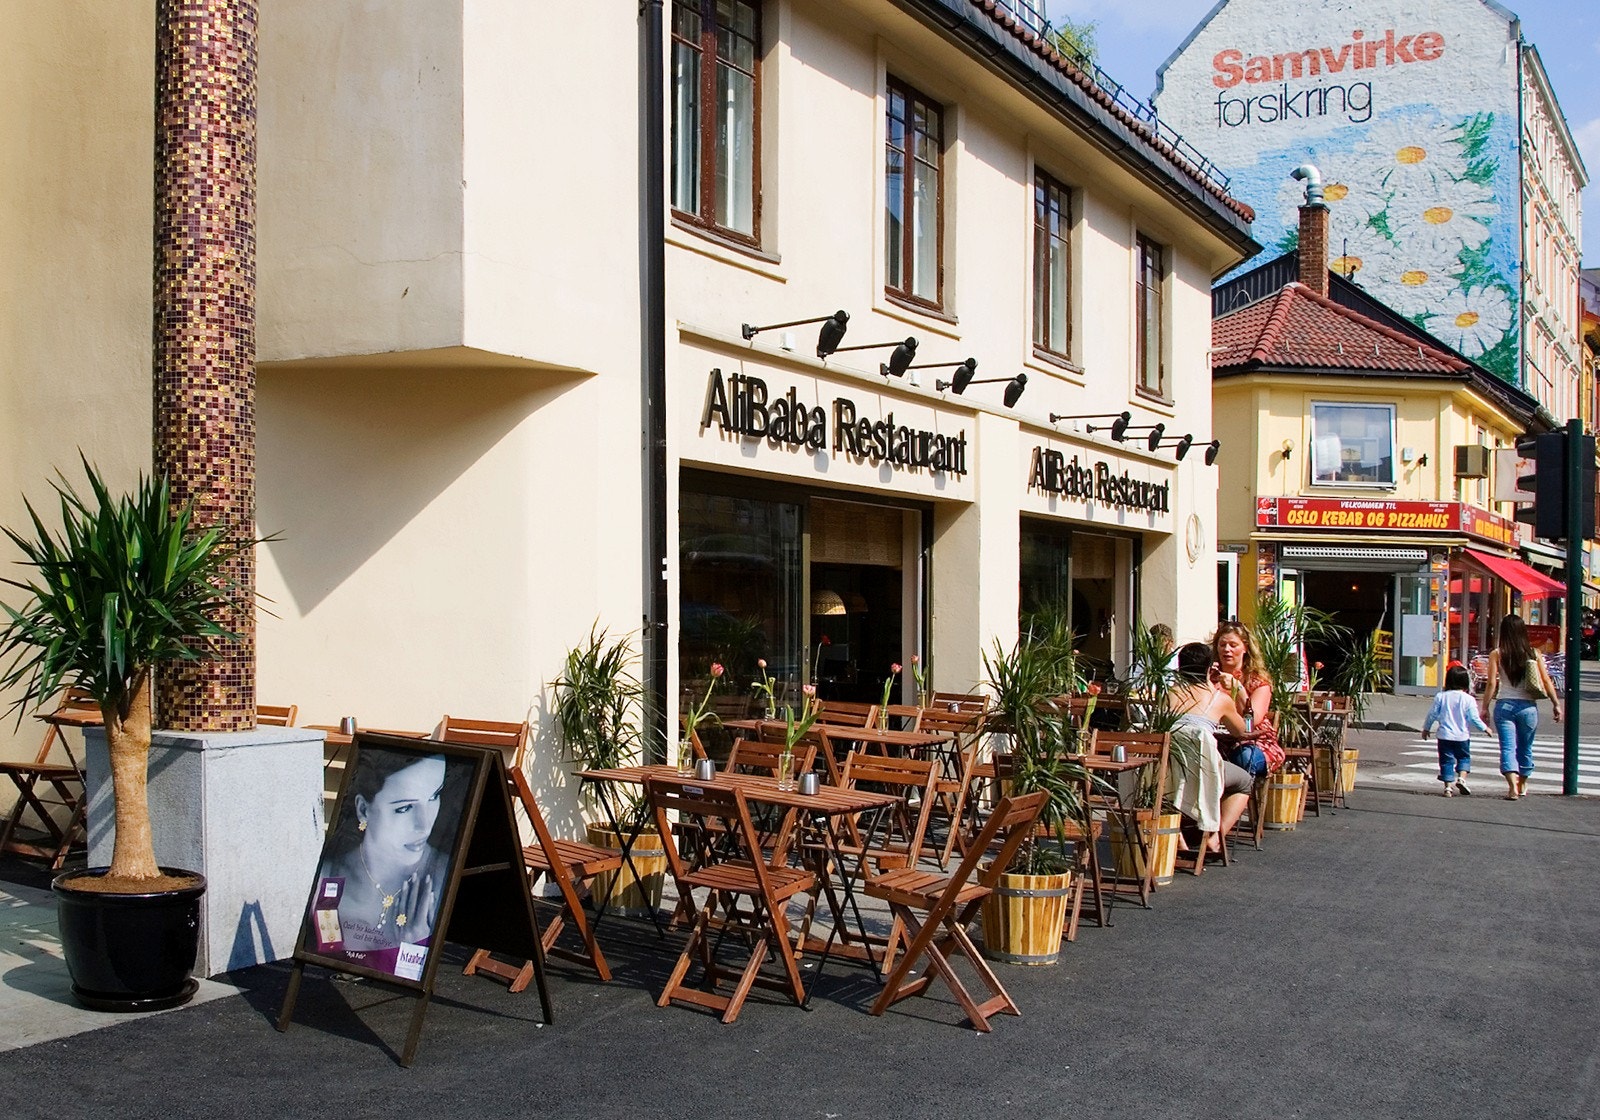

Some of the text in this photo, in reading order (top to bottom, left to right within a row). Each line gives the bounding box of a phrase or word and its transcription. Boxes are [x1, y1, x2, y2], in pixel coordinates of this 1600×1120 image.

[1212, 29, 1446, 89] Samvirke
[1214, 79, 1373, 128] forsikring
[701, 368, 967, 475] AliBaba Restaurant
[1095, 461, 1169, 513] Restaurant
[1340, 501, 1396, 510] VELKOMMEN TIL
[1287, 510, 1319, 525] OSLO
[1321, 511, 1363, 526] KEBAB
[1367, 513, 1384, 526] OG
[1388, 513, 1449, 529] PIZZAHUS
